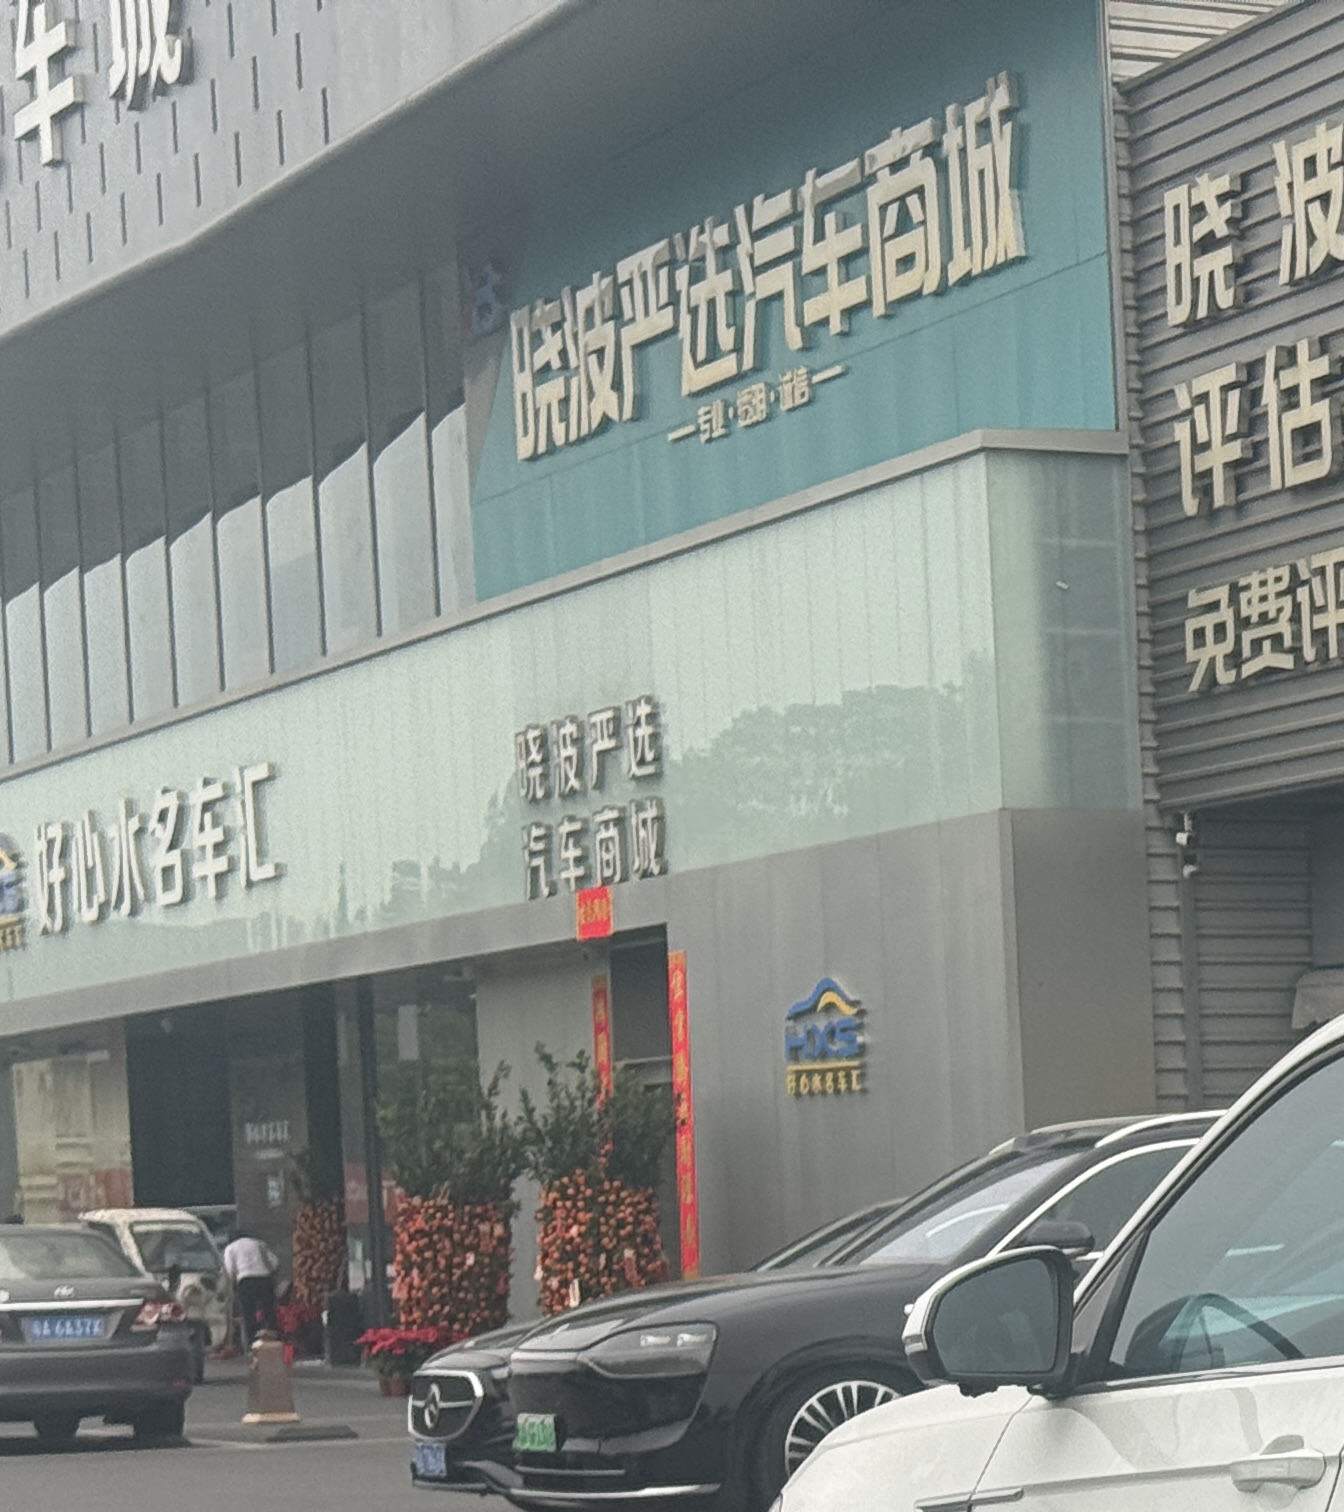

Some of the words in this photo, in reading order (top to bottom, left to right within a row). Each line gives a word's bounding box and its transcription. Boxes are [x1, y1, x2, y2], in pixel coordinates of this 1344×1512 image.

[510, 71, 1028, 461] 晓波严选汽车商城
[515, 695, 662, 803] 晓波严选
[34, 762, 280, 936] 好心水名车汇
[522, 798, 668, 901] 汽车商城
